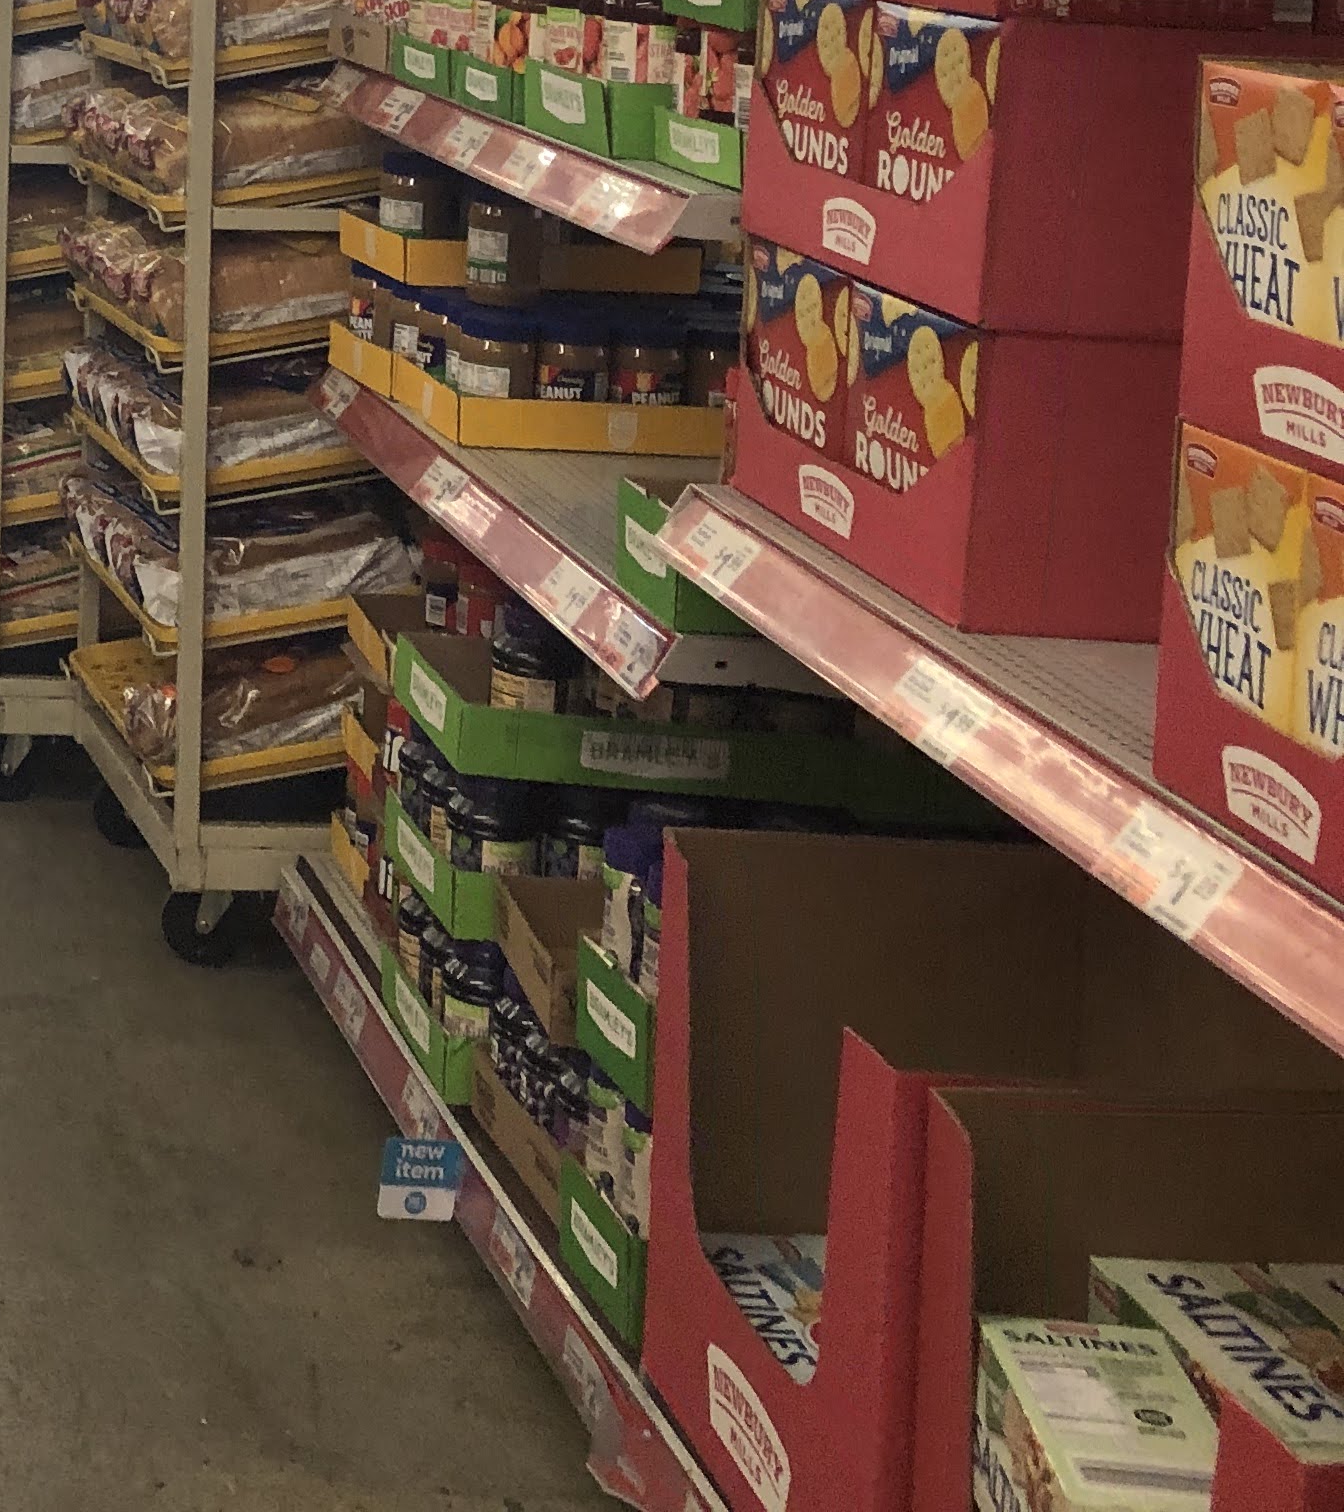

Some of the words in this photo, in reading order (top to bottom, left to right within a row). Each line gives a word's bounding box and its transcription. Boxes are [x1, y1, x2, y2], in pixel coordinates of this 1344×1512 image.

[777, 79, 825, 122] Golden
[782, 120, 849, 175] OUNDS
[886, 110, 946, 159] Golden
[877, 150, 955, 203] ROUN
[759, 339, 801, 390] Golden
[537, 384, 584, 400] EANUT
[762, 380, 826, 448] OUNDS
[863, 394, 919, 453] Golden
[855, 431, 929, 492] ROUN
[1228, 762, 1313, 827] NEWBURY
[395, 1158, 444, 1180] item
[399, 1143, 445, 1160] new
[1146, 1272, 1344, 1422] SALTINES
